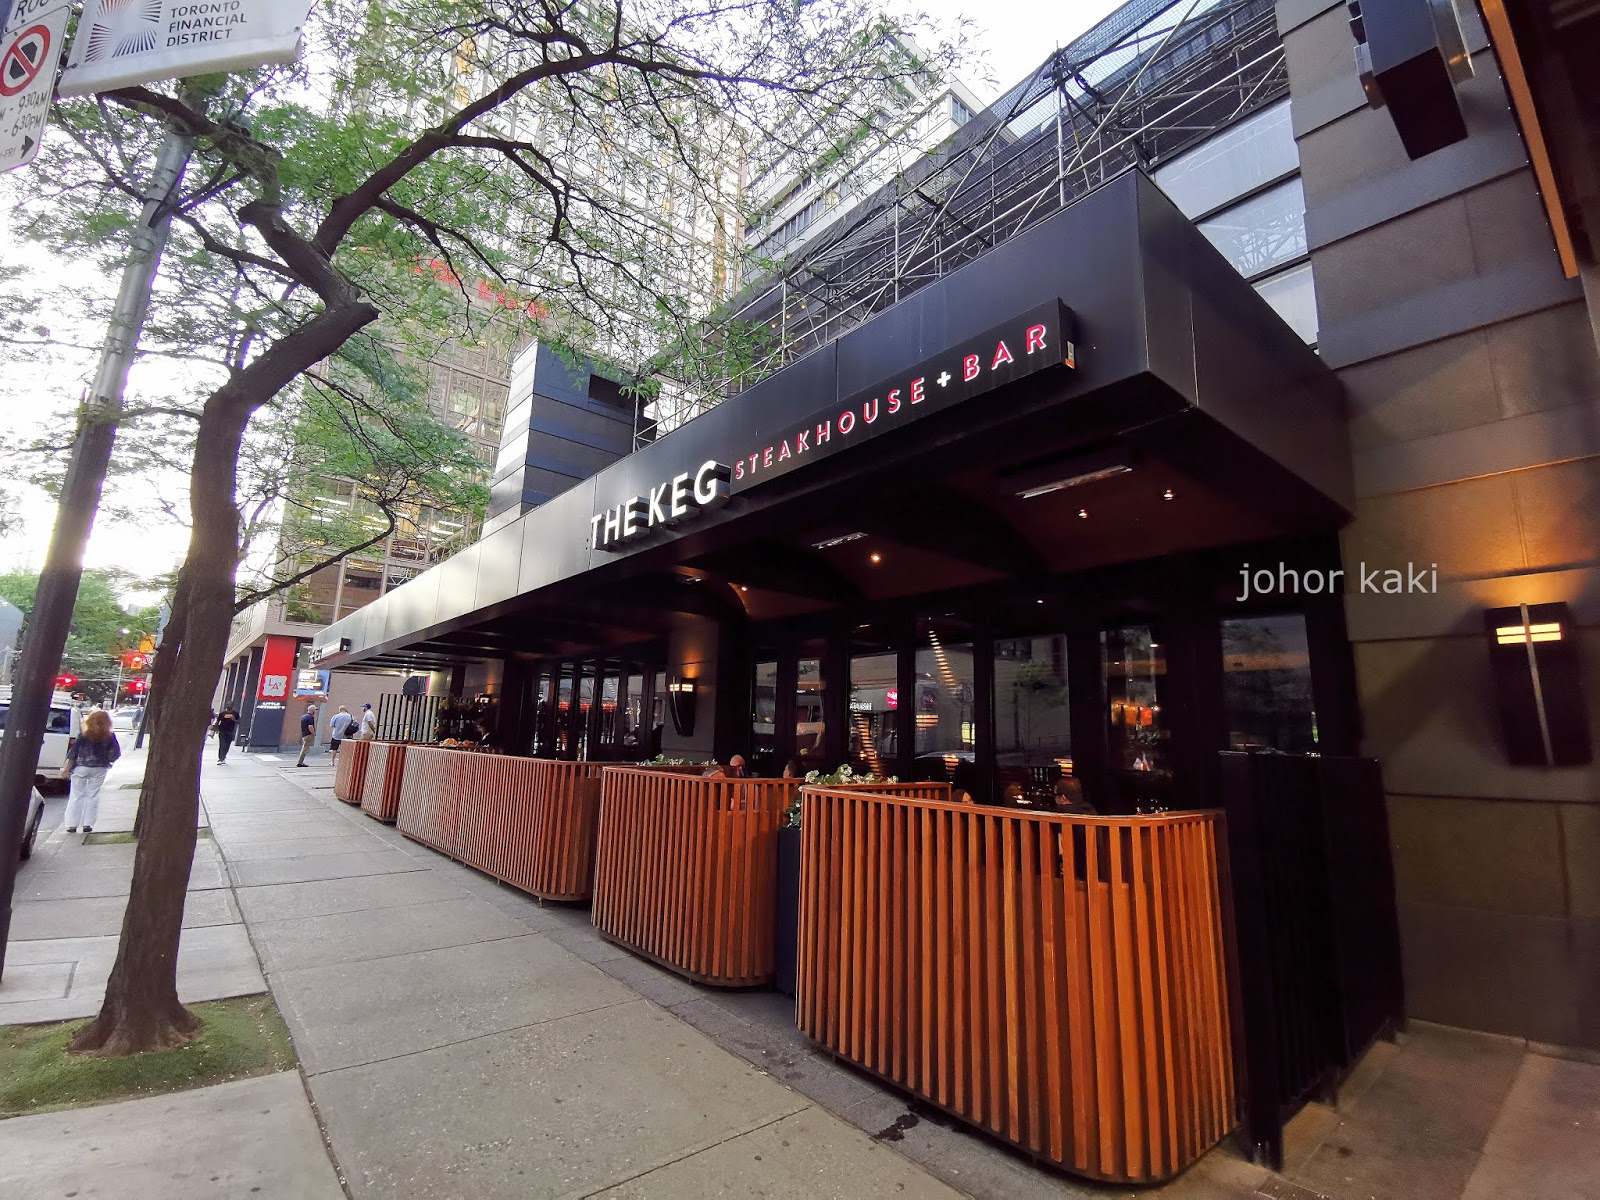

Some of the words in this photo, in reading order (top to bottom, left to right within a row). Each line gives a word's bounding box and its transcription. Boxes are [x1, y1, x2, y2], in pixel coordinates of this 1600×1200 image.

[171, 1, 240, 18] TORONTO
[169, 13, 247, 33] FINANCIAL
[166, 28, 233, 47] DISTRICT
[590, 495, 639, 550] THE
[648, 459, 718, 527] KEG
[735, 377, 925, 480] STEAKHOUSE
[963, 323, 1047, 382] BAR
